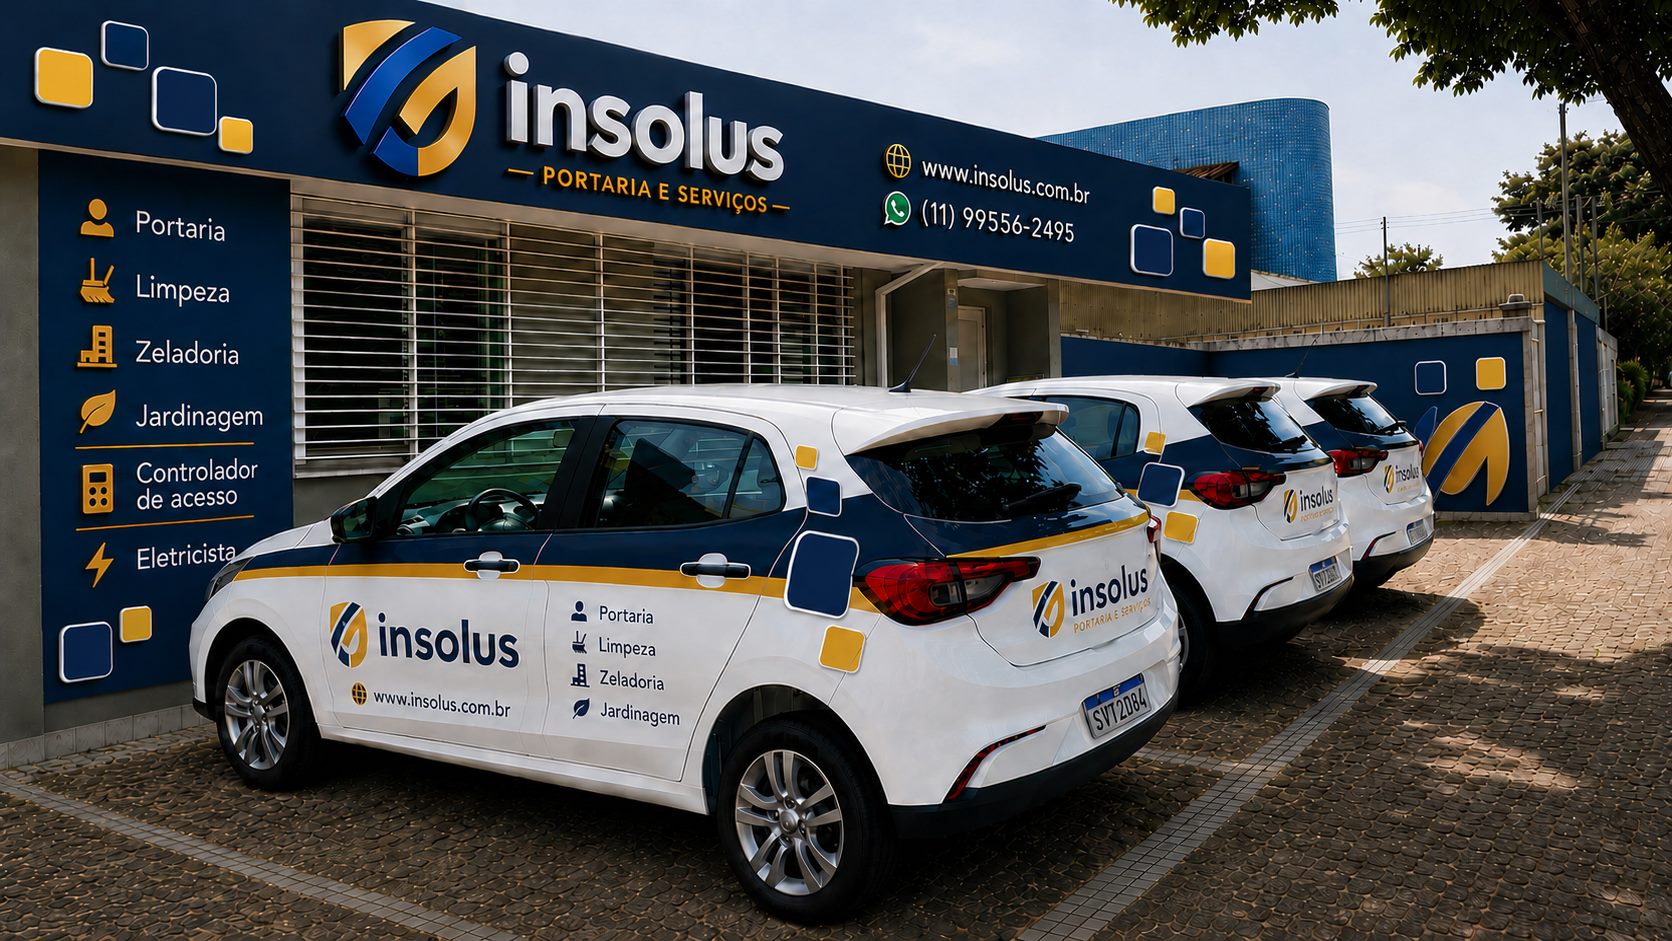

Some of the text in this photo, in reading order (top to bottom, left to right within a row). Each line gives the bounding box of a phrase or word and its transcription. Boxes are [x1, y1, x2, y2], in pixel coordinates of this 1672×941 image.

[504, 51, 784, 182] insolus
[543, 166, 767, 214] PORTARIA E SERVIÇOS
[922, 161, 1090, 203] www.insolus.com.br
[136, 210, 226, 241] Portaria
[922, 199, 1075, 243] (11) 99556-2495
[136, 274, 230, 307] Limpeza
[135, 339, 239, 365] Zeladoria
[135, 403, 263, 432] Jardinagem
[136, 457, 258, 483] Controlador
[136, 488, 238, 510] de acesso
[1300, 486, 1333, 511] insolus
[137, 542, 236, 570] Eletricista
[1071, 565, 1148, 616] insolus
[599, 605, 654, 624] Portaria
[1074, 613, 1112, 634] PORTARIA
[1114, 609, 1119, 620] E
[378, 612, 520, 669] insolus
[599, 636, 656, 657] Limpeza
[599, 669, 665, 691] Zeladoria
[373, 690, 511, 718] www.insolus.com.br
[600, 702, 680, 727] Jardinagem
[1093, 688, 1147, 731] SVT2D84
